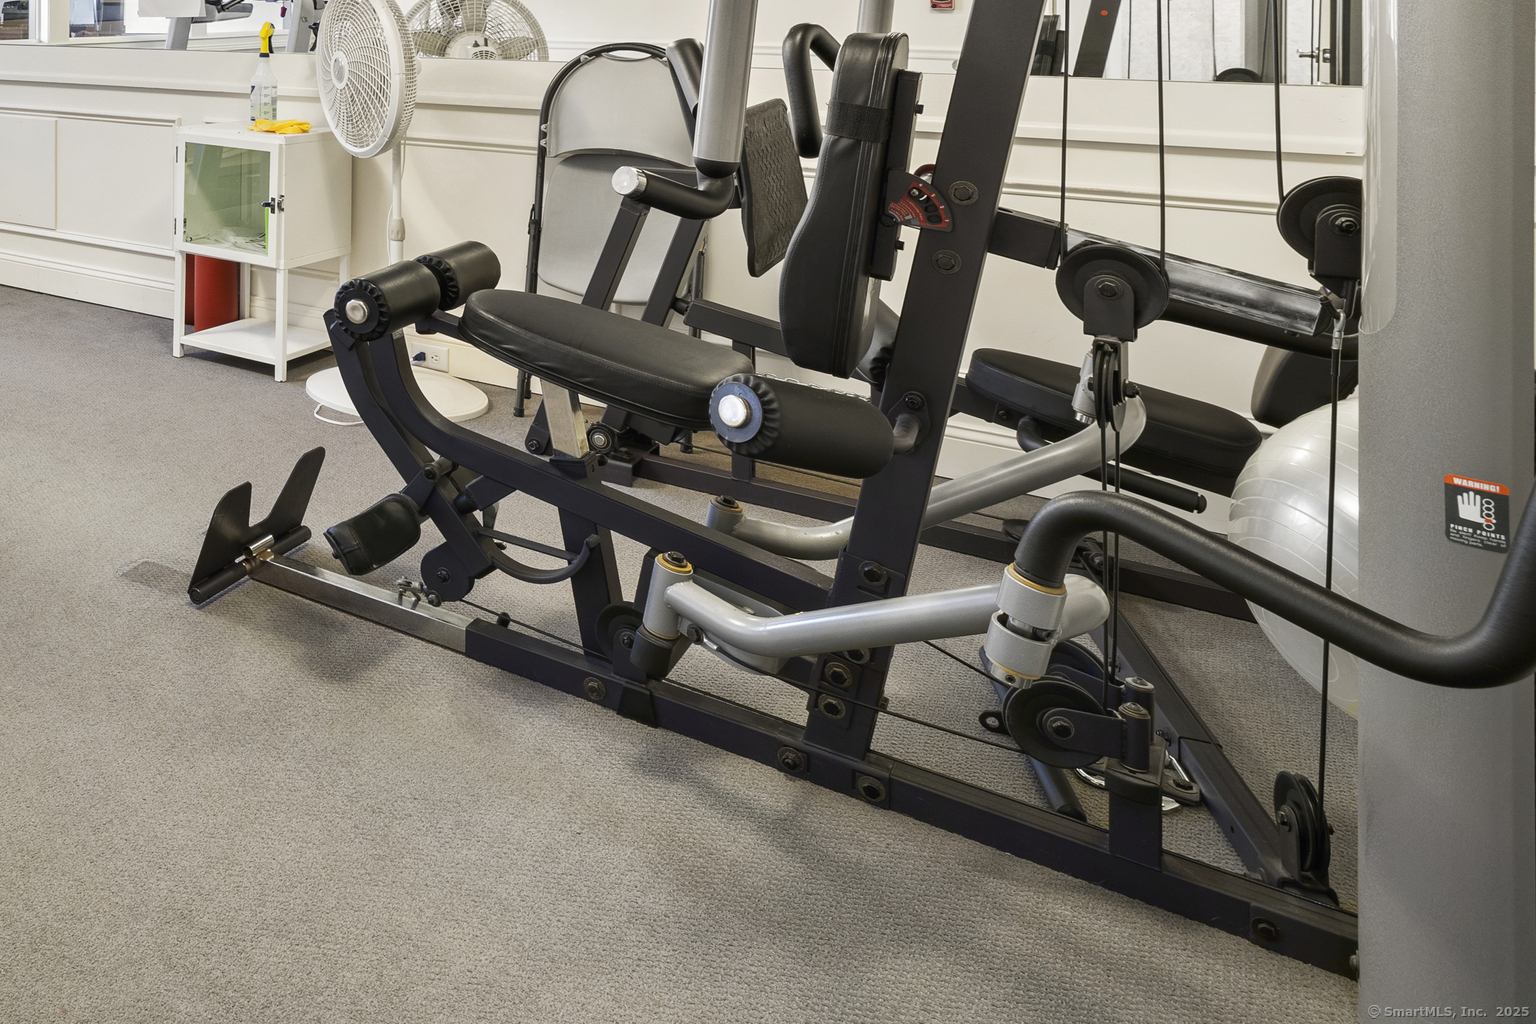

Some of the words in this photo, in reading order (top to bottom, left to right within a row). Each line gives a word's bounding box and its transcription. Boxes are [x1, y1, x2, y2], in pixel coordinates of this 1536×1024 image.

[1453, 477, 1500, 493] WARNING!
[1450, 523, 1473, 533] PINCH
[1476, 529, 1506, 540] POINTS
[1450, 536, 1469, 544] moving
